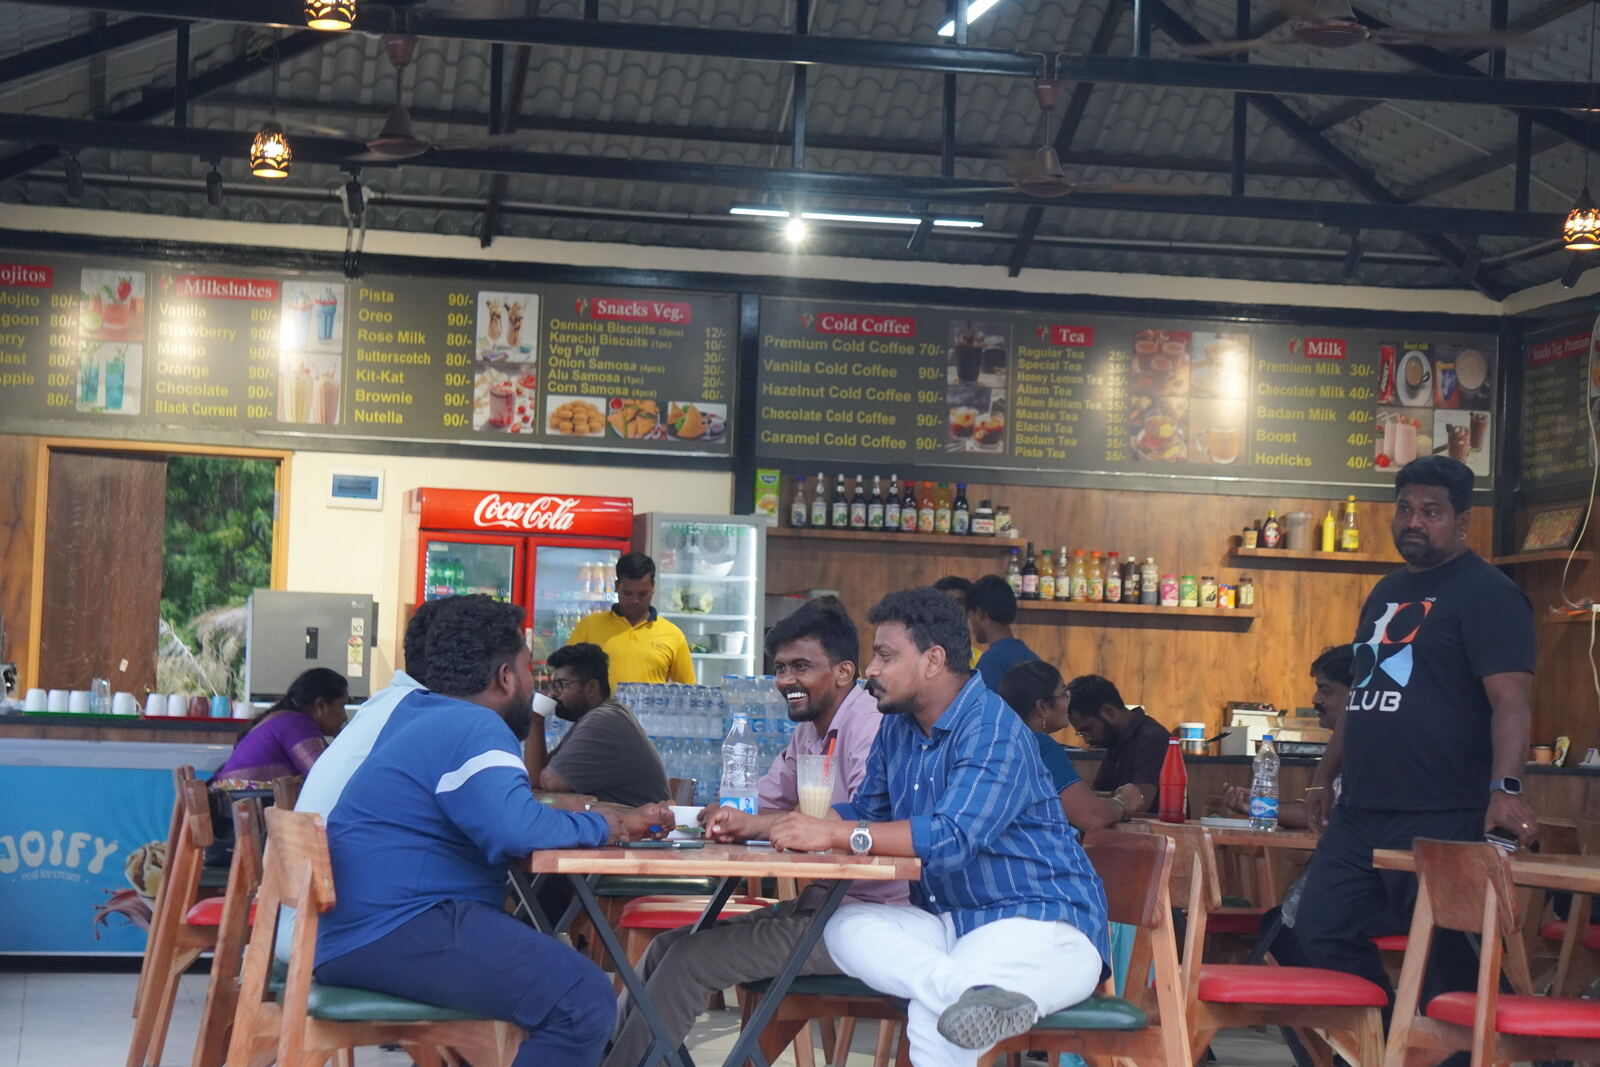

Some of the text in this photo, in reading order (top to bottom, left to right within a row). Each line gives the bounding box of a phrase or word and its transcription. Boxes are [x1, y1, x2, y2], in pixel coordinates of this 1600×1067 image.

[1, 267, 46, 283] ojitos
[184, 279, 272, 299] Milkshakes
[360, 288, 474, 306] Pista 90/-
[51, 295, 78, 308] 80/-
[160, 304, 207, 318] Vanilla
[358, 308, 473, 326] Oreo 90/-
[598, 301, 684, 321] Snacks Veg.
[0, 314, 78, 327] goon 80/-
[551, 319, 603, 332] Osmania
[608, 322, 655, 335] Biscuits
[705, 328, 726, 338] 12/-
[822, 317, 910, 334] Cold Coffee
[159, 322, 275, 341] Strawberry 90/-
[358, 329, 472, 346] Rose Milk 80/-
[1060, 329, 1085, 343] Tea
[49, 335, 76, 348] 80/-
[550, 332, 596, 344] Karachi
[600, 334, 648, 347] Biscuits
[705, 341, 726, 350] 10/-
[765, 335, 945, 355] Premium Cold Coffee 70/-
[1308, 342, 1342, 356] Milk
[157, 342, 275, 360] Mango 90/-
[357, 349, 472, 366] Butterscotch 80/-
[550, 345, 725, 363] Veg Puff 30/-
[1018, 347, 1062, 358] Regular
[1066, 349, 1084, 359] Tea
[0, 354, 75, 367] last 80/-
[548, 358, 585, 369] Onion
[589, 359, 637, 371] Samosa
[704, 366, 725, 375] 30/-
[1018, 359, 1059, 372] Special
[1063, 361, 1082, 372] Tea
[1258, 360, 1374, 376] Premium Milk 30/-
[157, 361, 274, 379] Orange 90/-
[356, 370, 471, 386] Kit-Kat 90/-
[763, 360, 944, 379] Vanilla Cold Coffee 90/-
[0, 373, 74, 386] pple 80/-
[548, 370, 569, 380] Alu
[572, 371, 620, 383] Samosa
[702, 378, 724, 388] 20/-
[1017, 372, 1048, 385] Honey
[1050, 373, 1084, 384] Lemon
[1086, 375, 1103, 386] Tea
[156, 381, 273, 399] Chocolate 90/-
[355, 389, 470, 406] Brownie 90/-
[548, 382, 577, 393] Corn
[580, 384, 629, 396] Samosa
[702, 391, 724, 400] 40/-
[763, 383, 943, 402] Hazelnut Cold Coffee 90/-
[1017, 385, 1049, 395] Allam
[1053, 386, 1072, 396] Tea
[1258, 383, 1374, 400] Chocolate Milk 40/-
[47, 394, 73, 406] 80/-
[1016, 397, 1045, 408] Allam
[1084, 399, 1102, 410] Tea
[155, 401, 272, 418] Black Current 90/-
[355, 409, 469, 427] Nutella 90/-
[762, 407, 942, 426] Chocolate Cold Coffee 90/-
[1016, 410, 1056, 421] Masala
[1059, 411, 1078, 421] Tea
[1257, 406, 1373, 423] Badam Milk 40/-
[1016, 422, 1051, 433] Elachi
[1054, 424, 1073, 434] Tea
[761, 431, 942, 449] Caramel Cold Coffee 90/-
[1015, 435, 1054, 446] Badam
[1058, 436, 1078, 447] Tea
[1256, 430, 1372, 446] Boost 40/-
[1015, 447, 1044, 457] Pista
[1047, 448, 1066, 458] Tea
[1256, 453, 1371, 469] Horlicks 40/-
[473, 493, 580, 530] Coca-Cola
[1346, 690, 1402, 712] LUB
[0, 830, 118, 874] JOIFY
